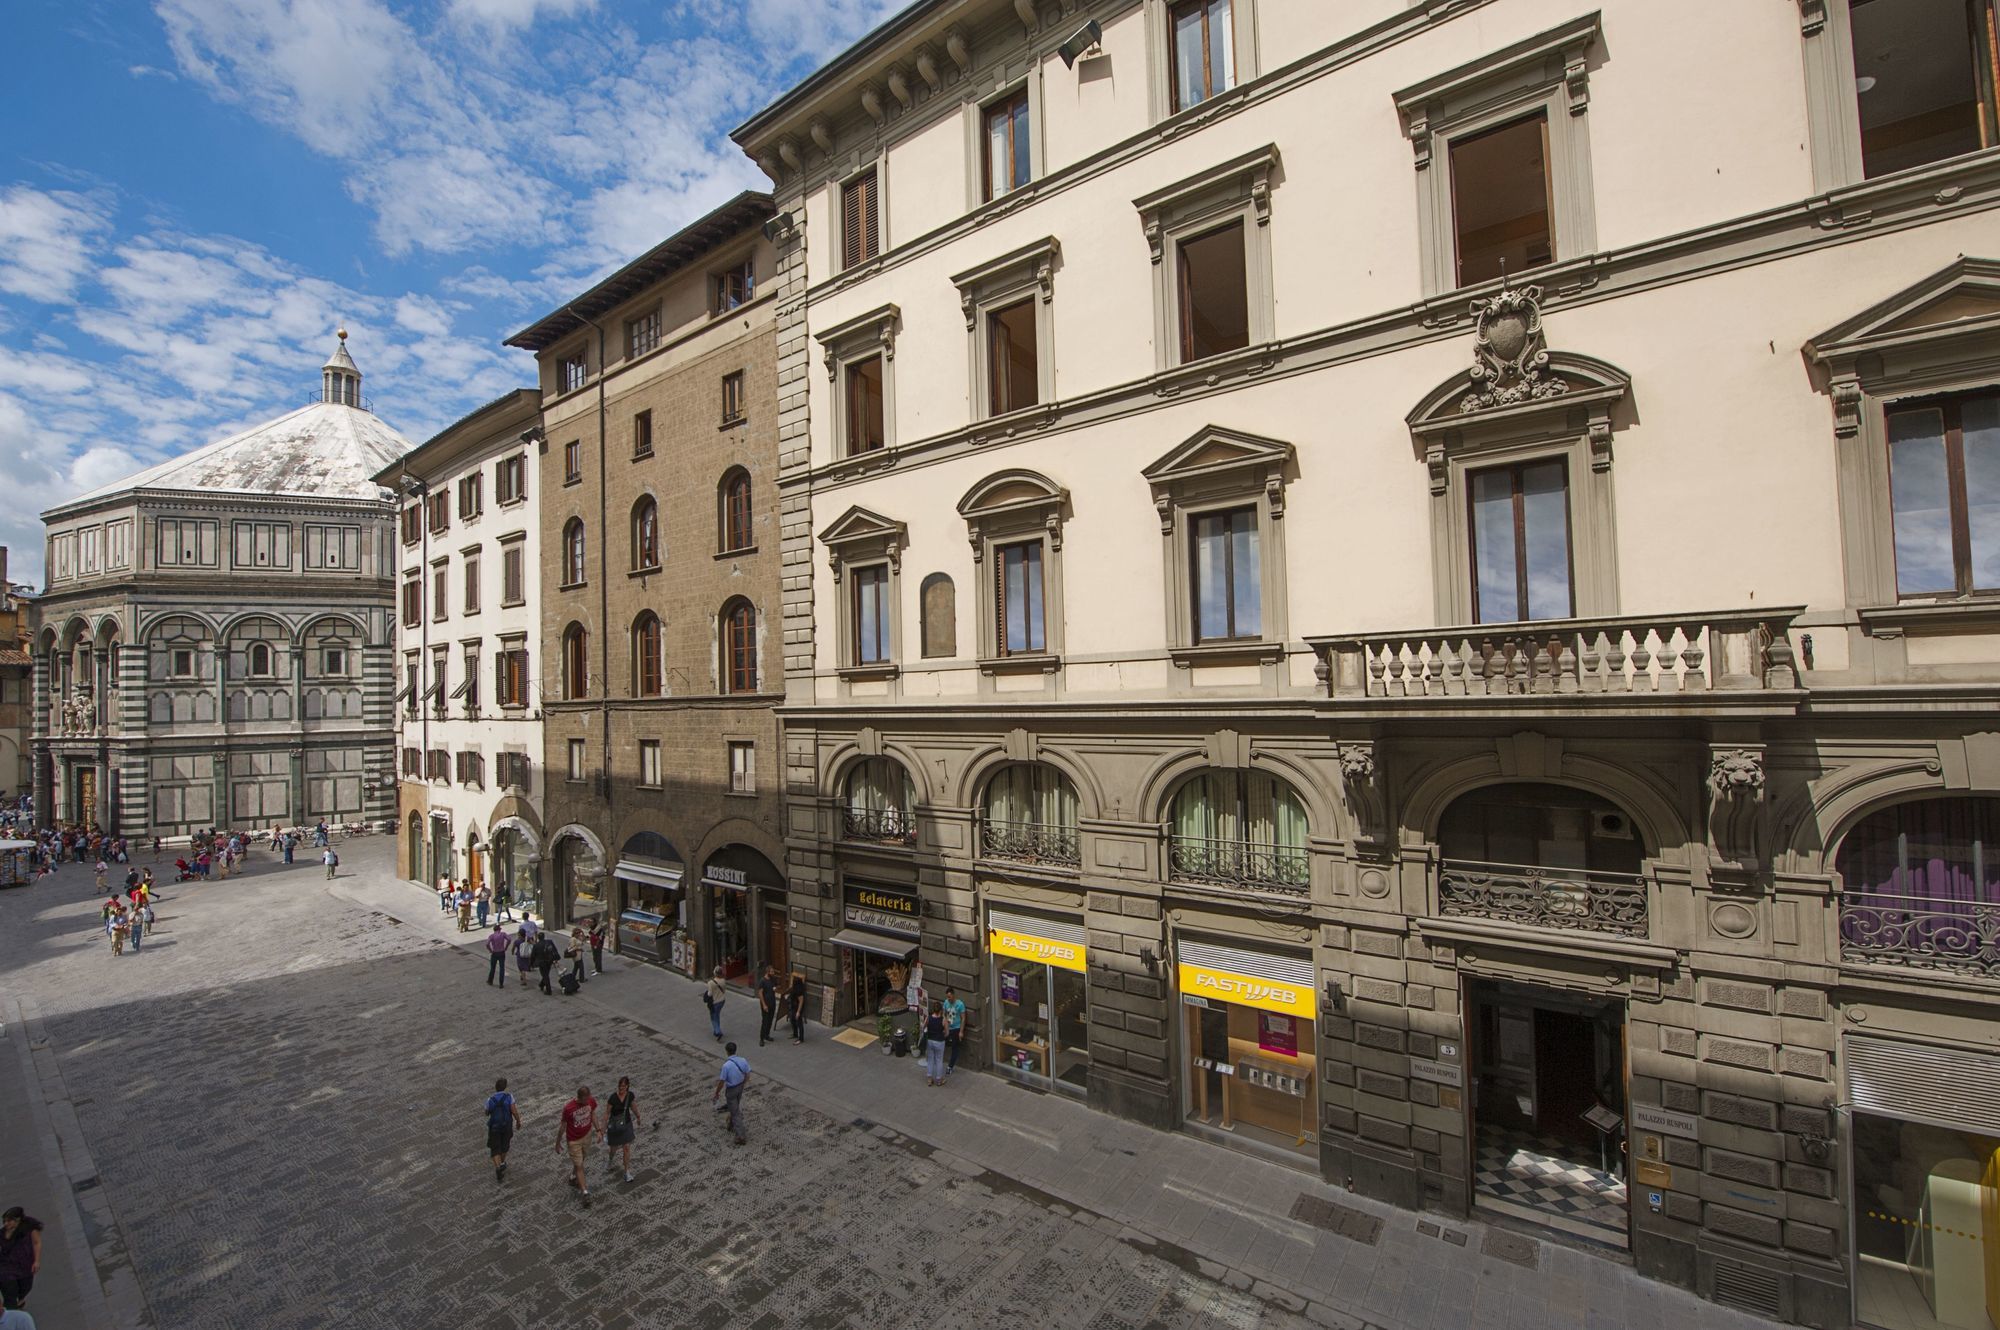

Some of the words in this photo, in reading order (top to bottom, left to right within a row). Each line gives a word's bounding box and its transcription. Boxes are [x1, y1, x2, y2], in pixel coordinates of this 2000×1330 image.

[707, 865, 747, 885] ROSSINI
[859, 891, 912, 911] gelateria
[877, 914, 886, 926] del
[1002, 936, 1075, 960] FASTWEB
[1196, 973, 1296, 1005] FASTWEB
[1414, 1064, 1436, 1074] PALAZZO
[1637, 1112, 1665, 1125] PALAZZO
[1666, 1118, 1693, 1131] RUSPOLI
